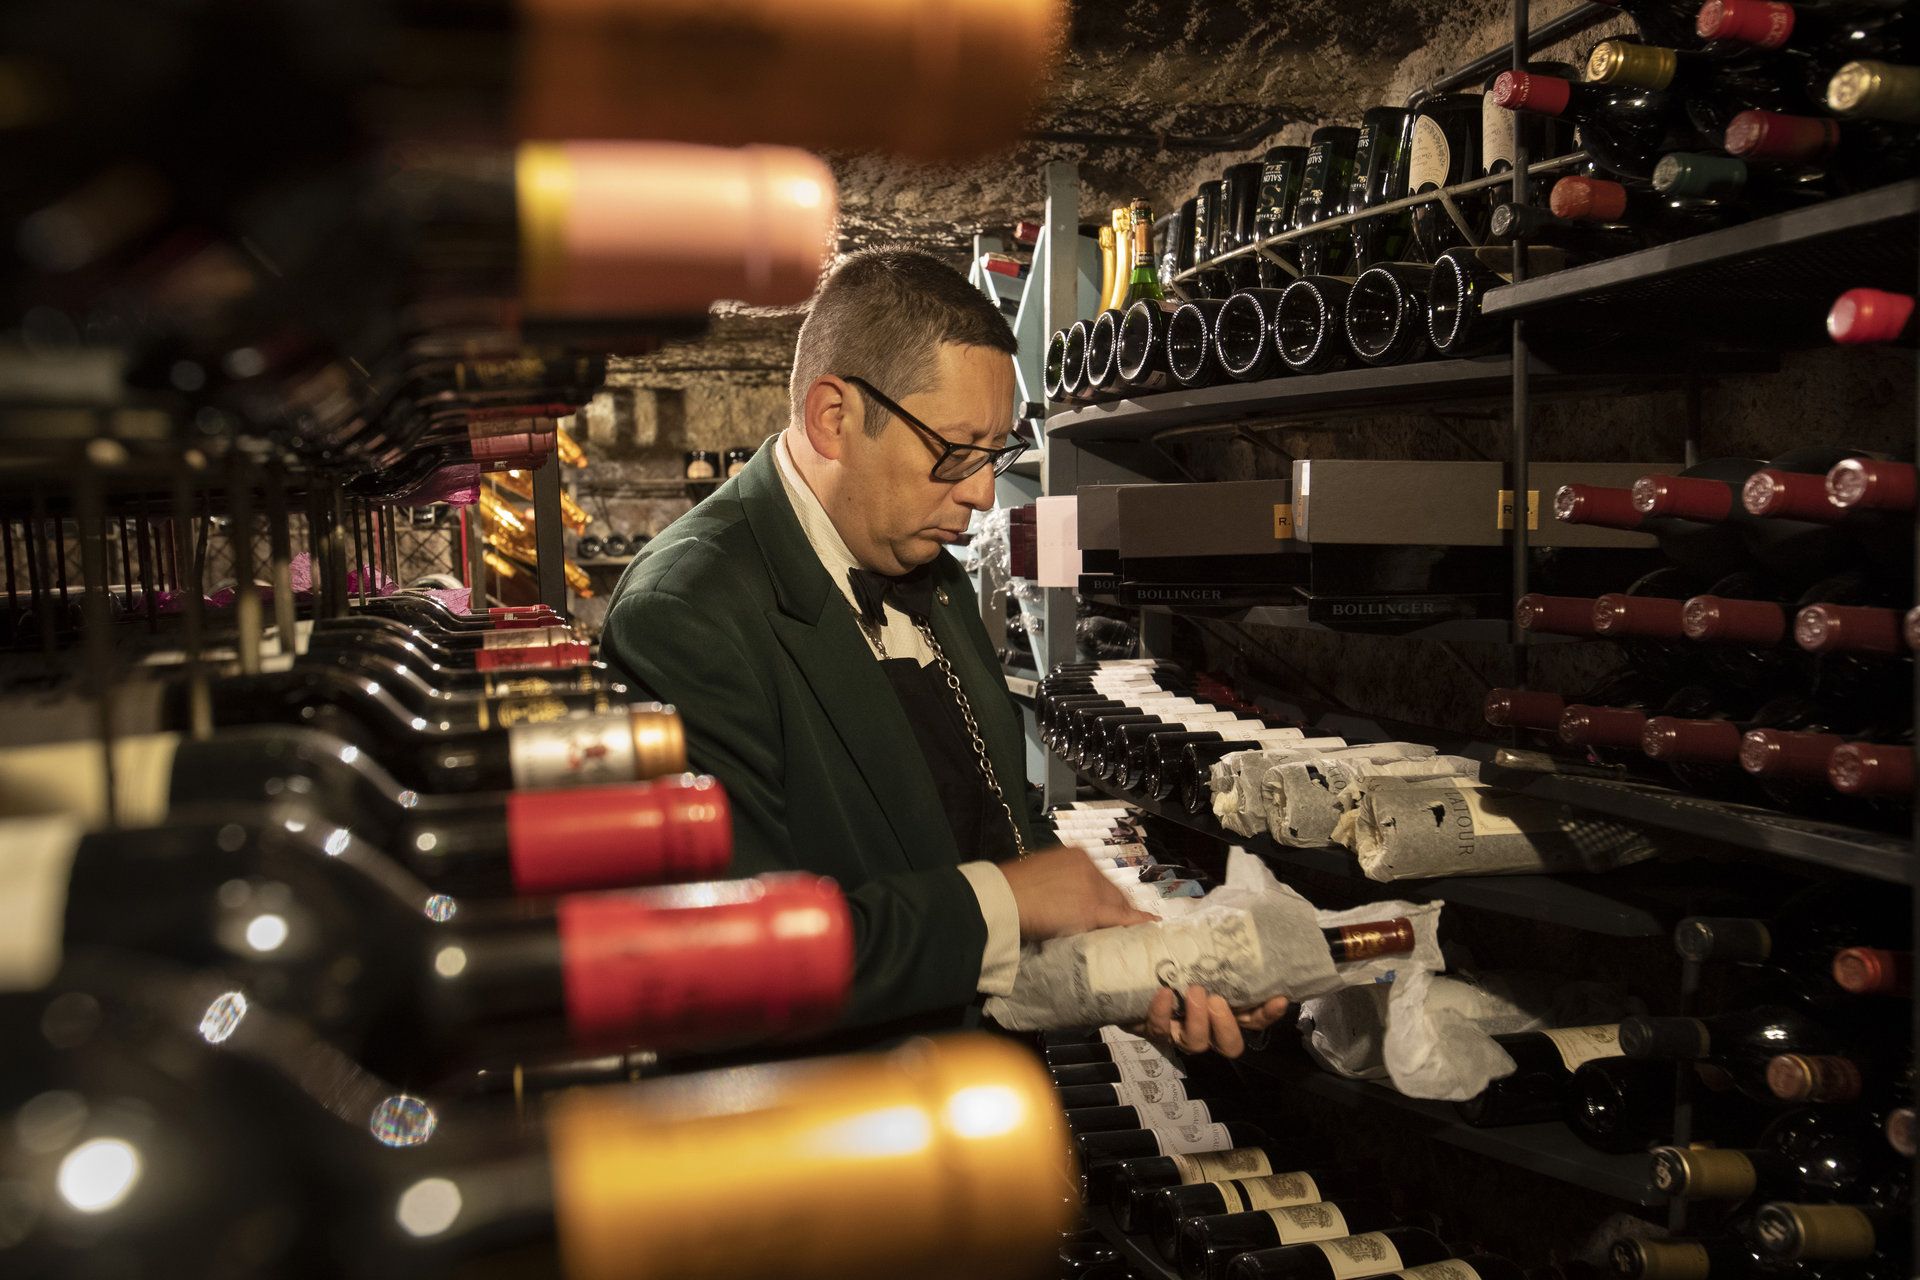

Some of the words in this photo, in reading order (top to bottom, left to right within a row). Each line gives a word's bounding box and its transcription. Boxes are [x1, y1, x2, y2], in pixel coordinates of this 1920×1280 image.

[1262, 173, 1283, 183] SALON
[1136, 589, 1223, 601] BOLLINGER
[1332, 602, 1435, 617] BOLLINGER
[1444, 791, 1475, 857] LATOUR
